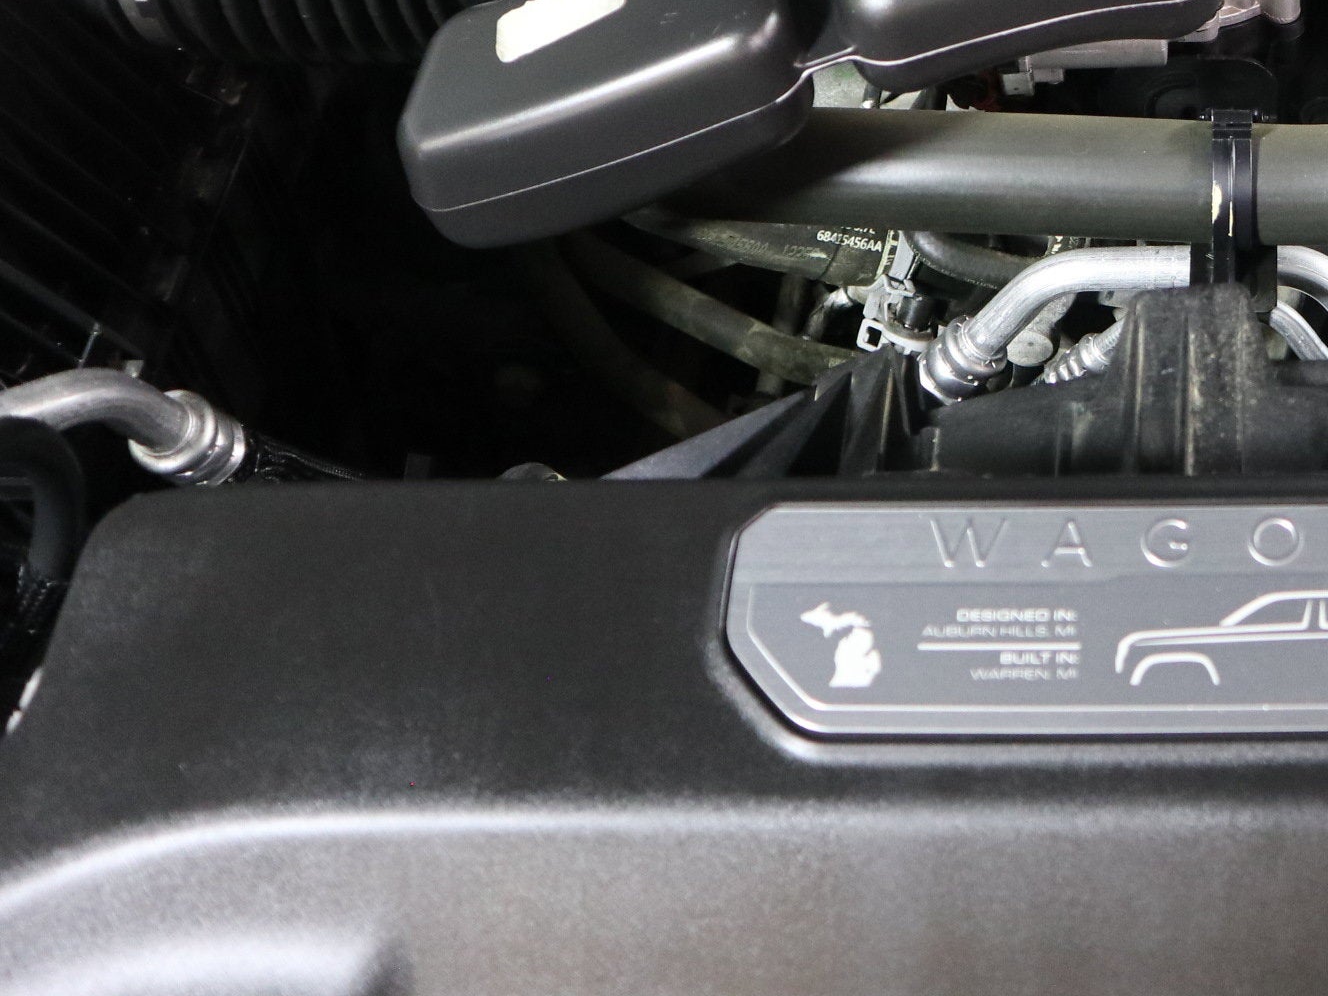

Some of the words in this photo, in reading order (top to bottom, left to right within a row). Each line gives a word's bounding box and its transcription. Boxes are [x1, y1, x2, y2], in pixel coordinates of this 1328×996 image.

[816, 229, 883, 253] 68415456AA
[956, 608, 1050, 622] DESIGNED
[921, 624, 996, 637] AUBURN
[1000, 651, 1051, 664] BUILT
